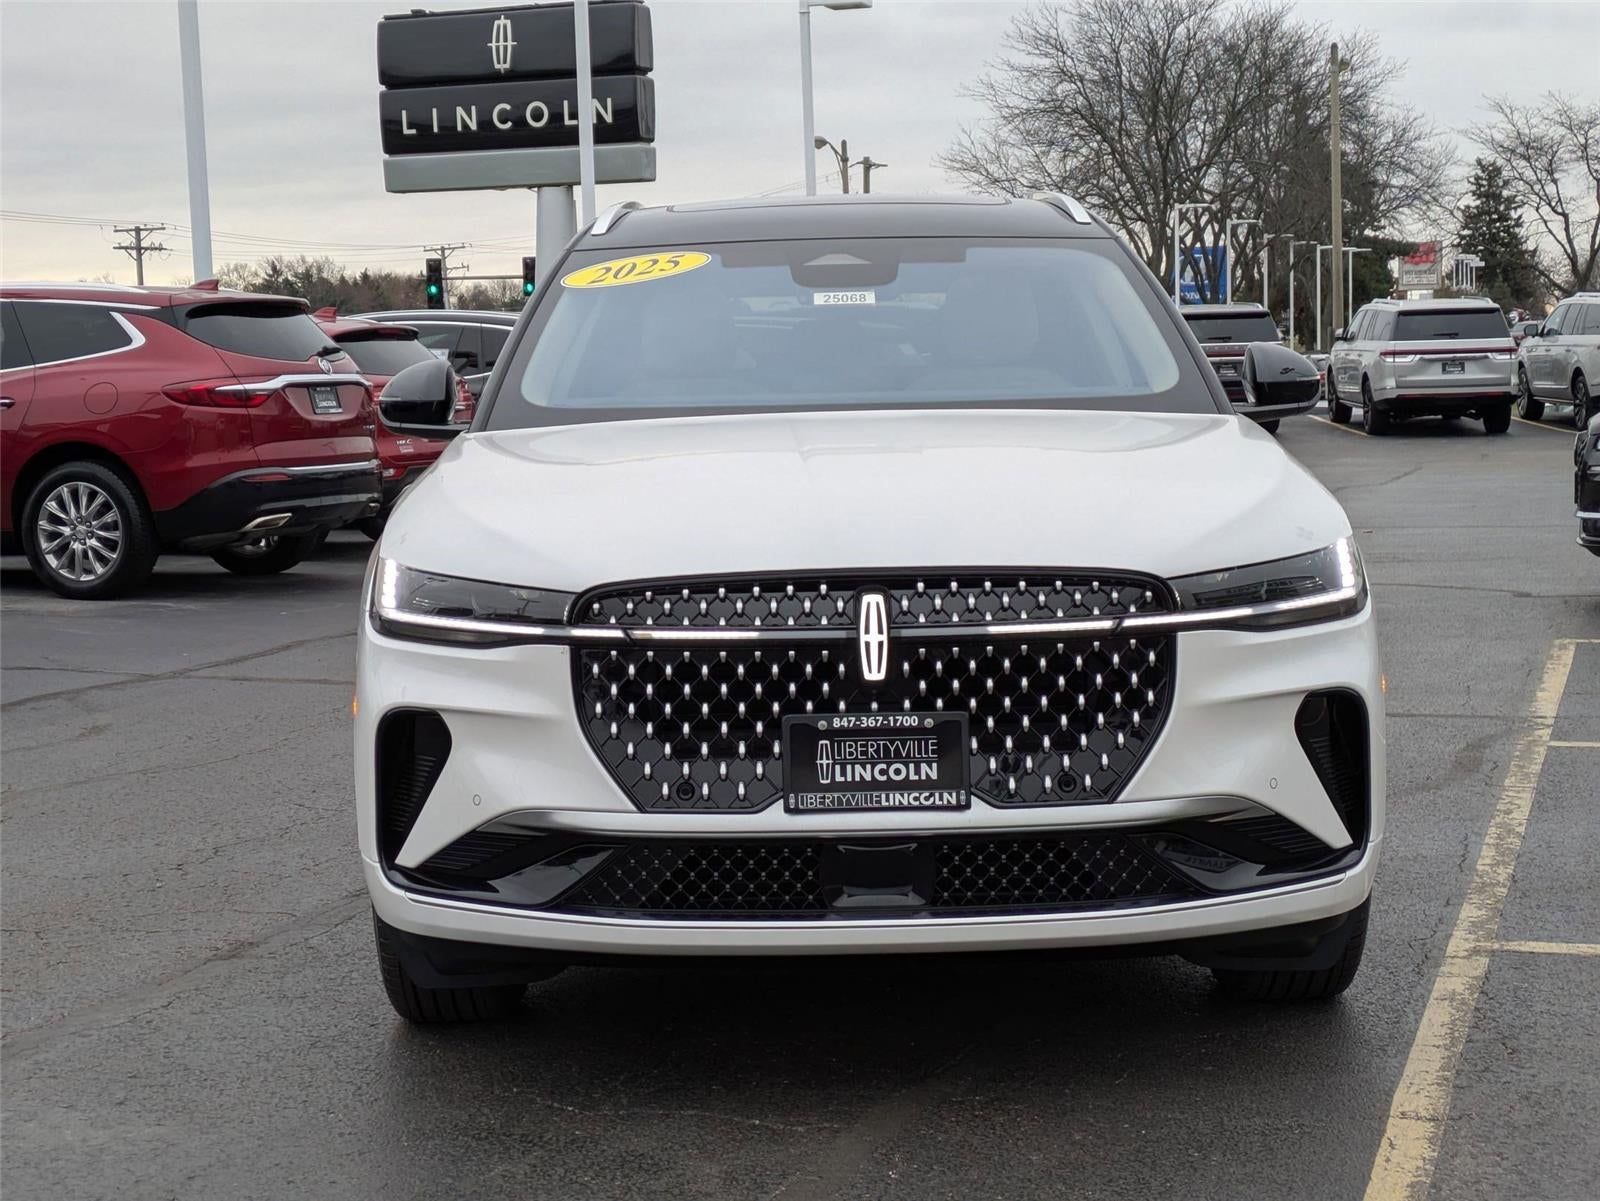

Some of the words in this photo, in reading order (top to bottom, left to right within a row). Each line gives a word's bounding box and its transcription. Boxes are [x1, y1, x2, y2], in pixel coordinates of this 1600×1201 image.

[402, 97, 613, 135] LINCOLN
[586, 254, 686, 285] 2025
[823, 293, 867, 304] 25068
[832, 715, 919, 728] 847-367-1700
[834, 739, 938, 760] LIBERTYVILLE
[835, 762, 938, 782] LINCOLN
